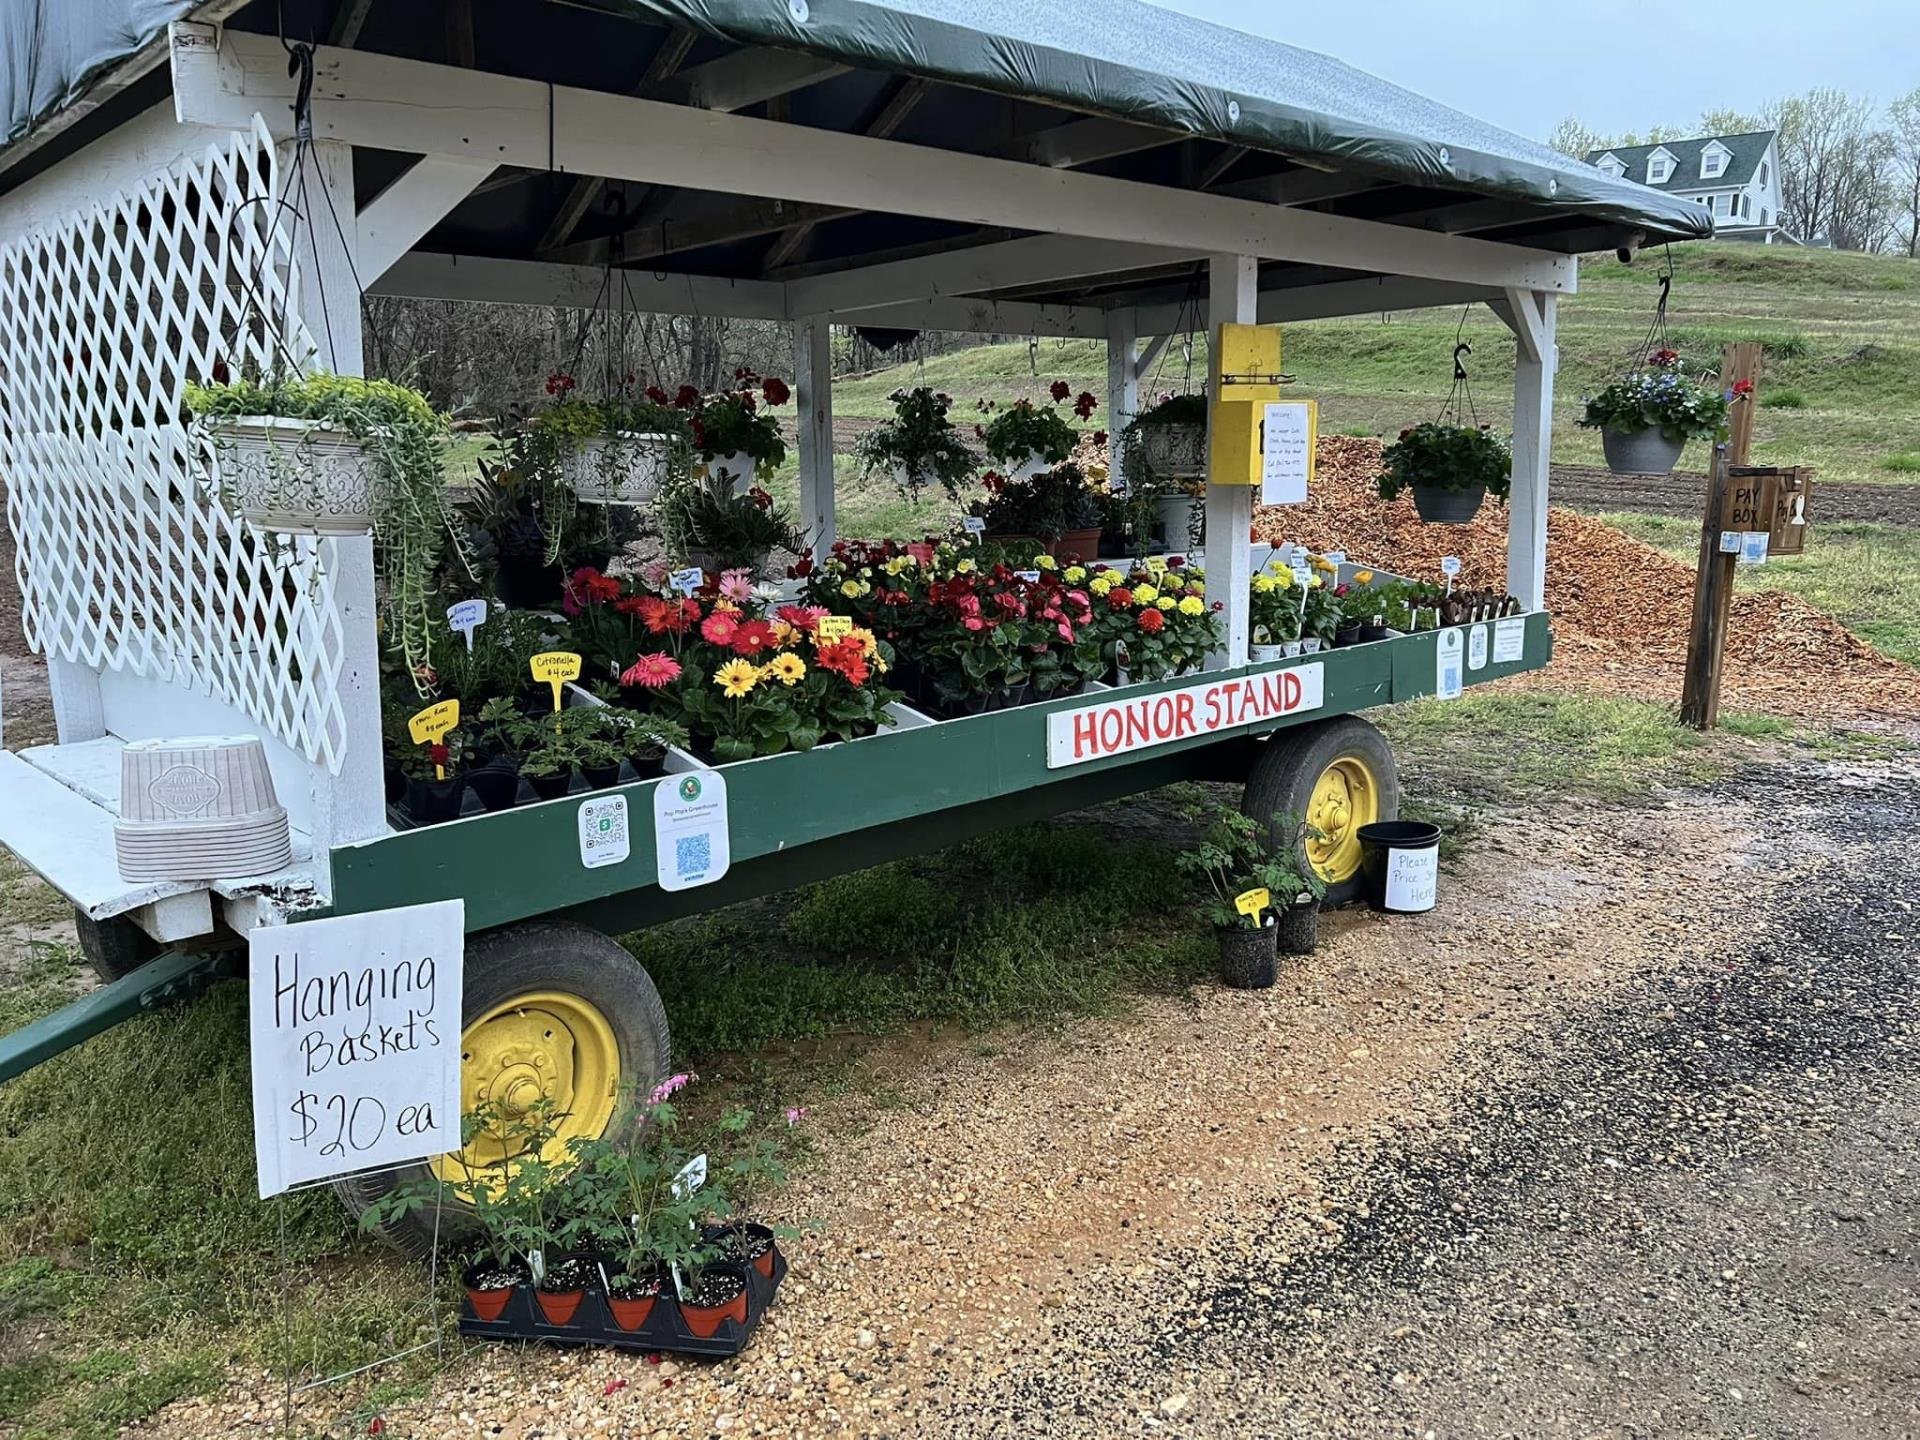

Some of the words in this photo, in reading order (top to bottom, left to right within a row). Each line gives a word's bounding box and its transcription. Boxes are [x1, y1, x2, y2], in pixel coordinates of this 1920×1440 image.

[1735, 487, 1760, 505] PAY
[1732, 508, 1758, 525] BOX
[547, 669, 560, 678] $4
[561, 669, 575, 677] each
[1073, 693, 1197, 759] HONOR
[1205, 672, 1302, 730] STAND
[1398, 854, 1429, 869] Please
[1392, 869, 1418, 884] Price
[274, 952, 436, 1039] Hanging
[299, 1009, 441, 1077] Baskets
[289, 1090, 387, 1158] $20
[396, 1102, 442, 1137] ea
